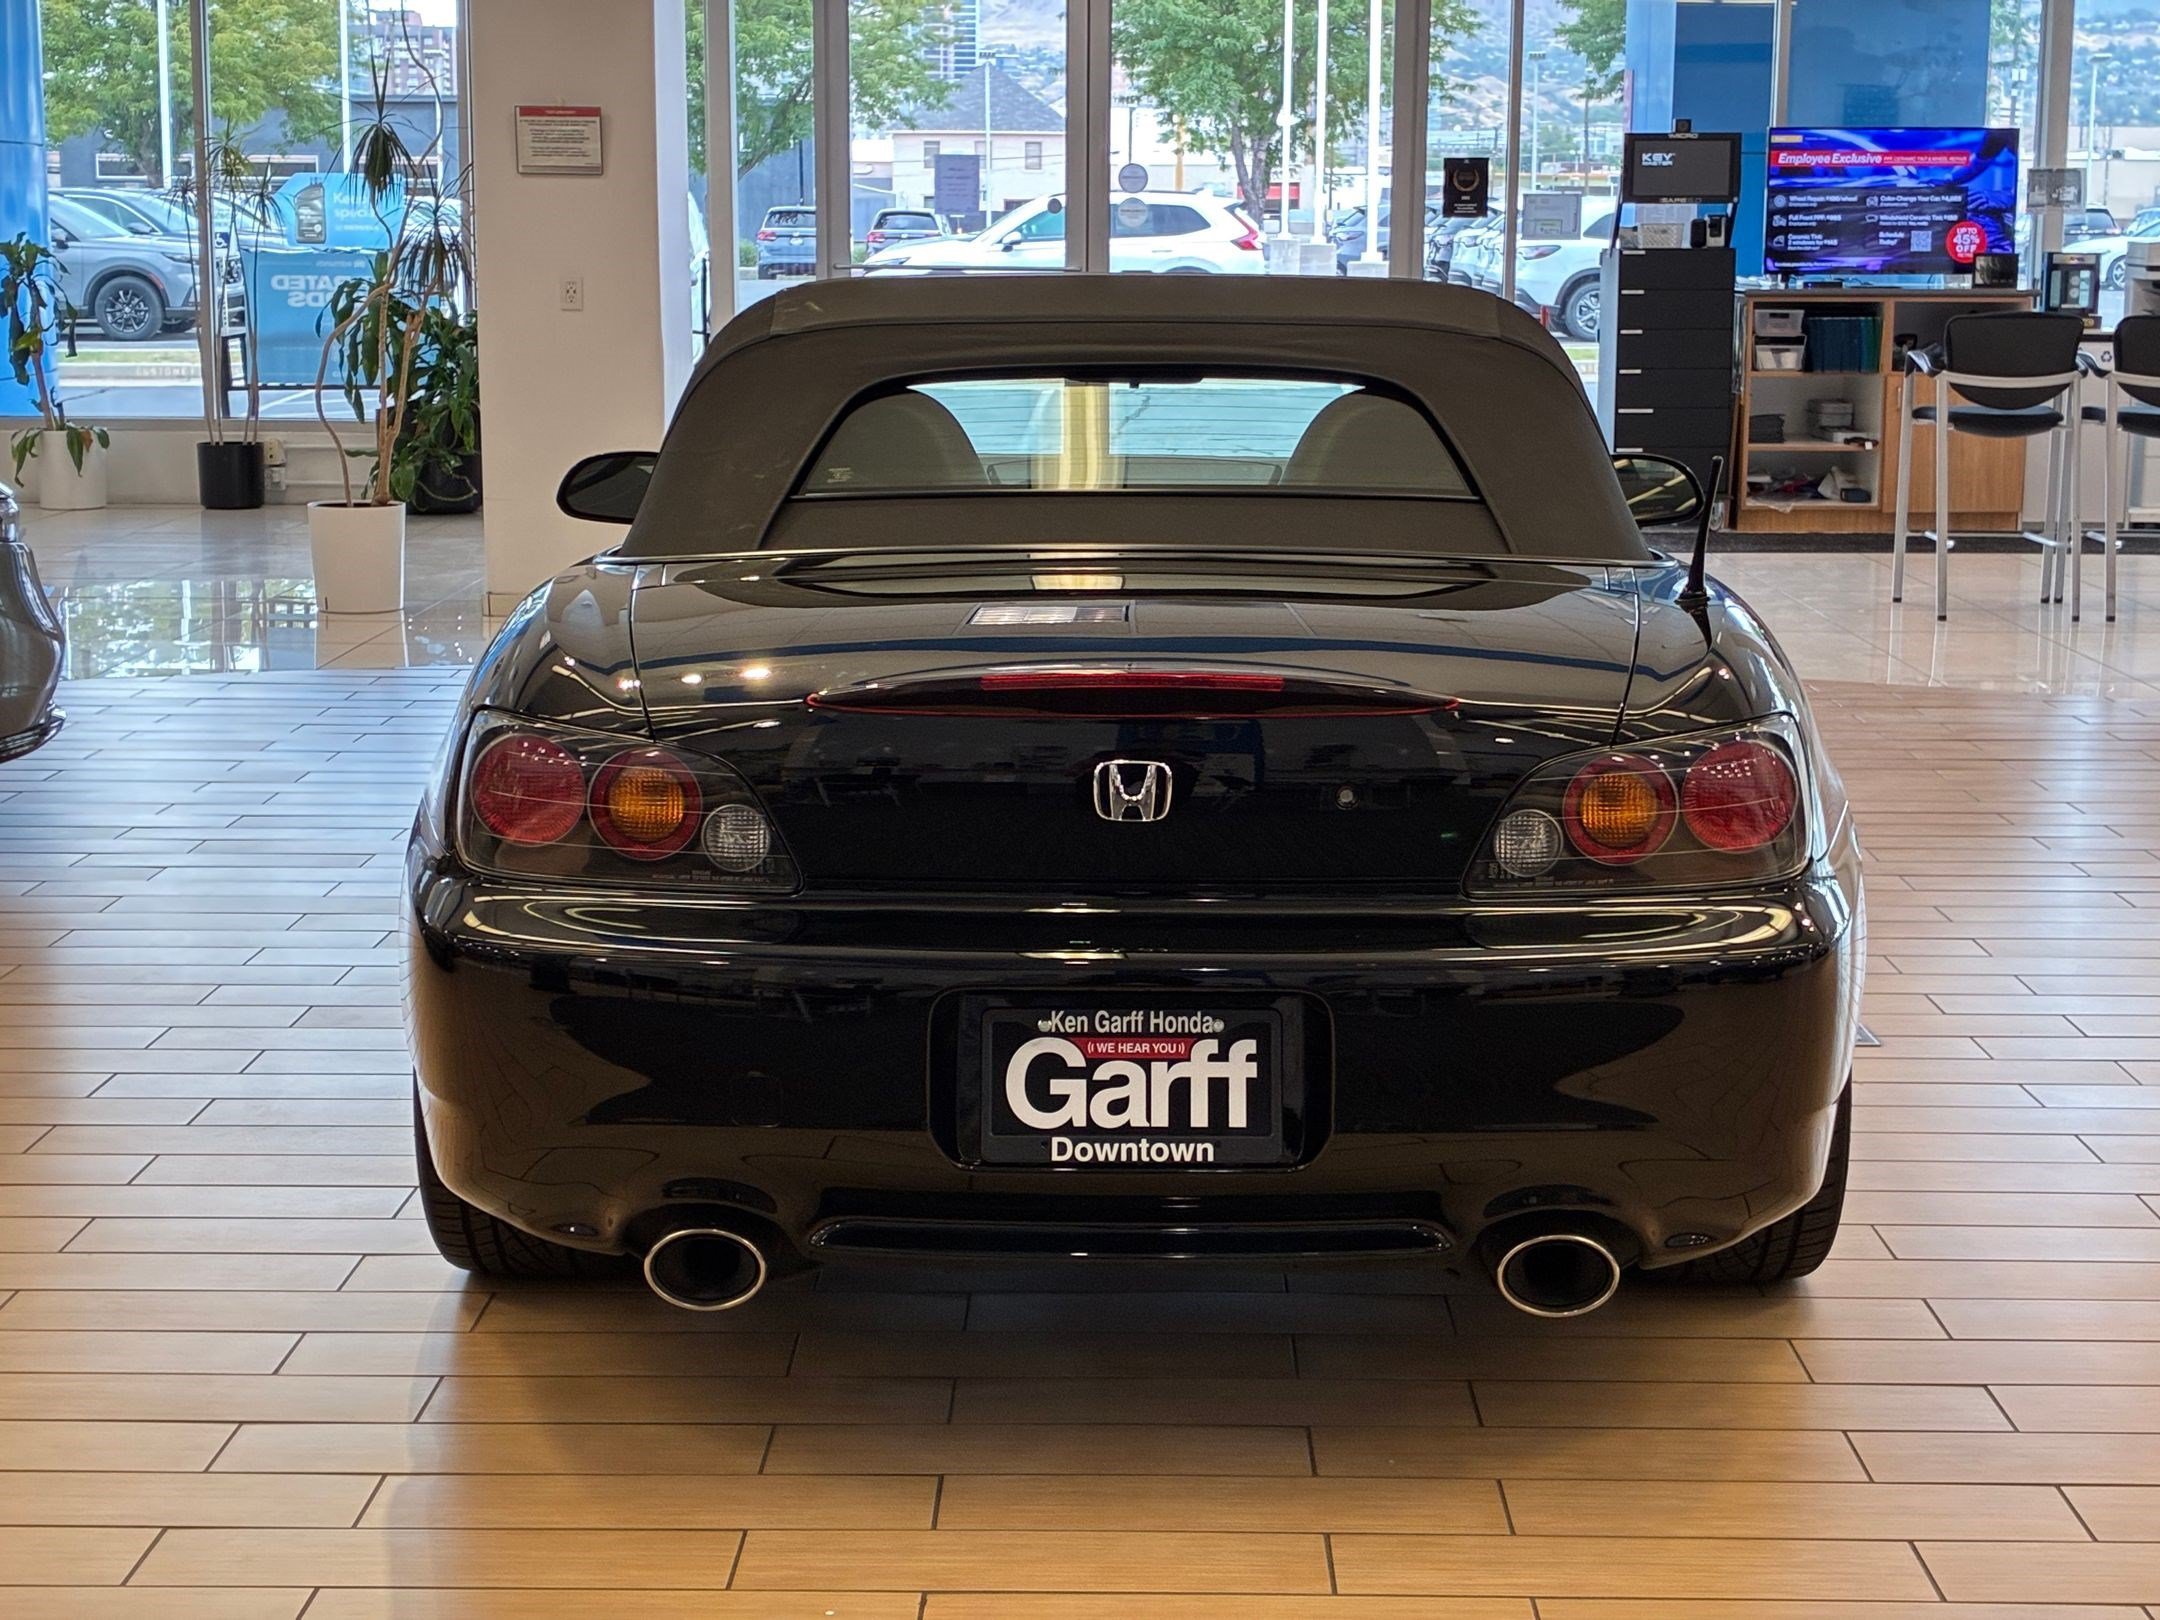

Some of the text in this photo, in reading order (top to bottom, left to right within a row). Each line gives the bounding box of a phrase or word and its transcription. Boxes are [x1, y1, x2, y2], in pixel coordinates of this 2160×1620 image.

[1778, 153, 1830, 166] Employee
[1832, 152, 1882, 164] Exclusive
[1952, 233, 1980, 245] 45%
[1956, 244, 1977, 253] OFF
[1051, 1010, 1213, 1034] Ken Garff Honda
[1096, 1042, 1178, 1054] WE HEAR YOU
[1005, 1036, 1258, 1129] Garff
[1051, 1136, 1215, 1162] Downtown
